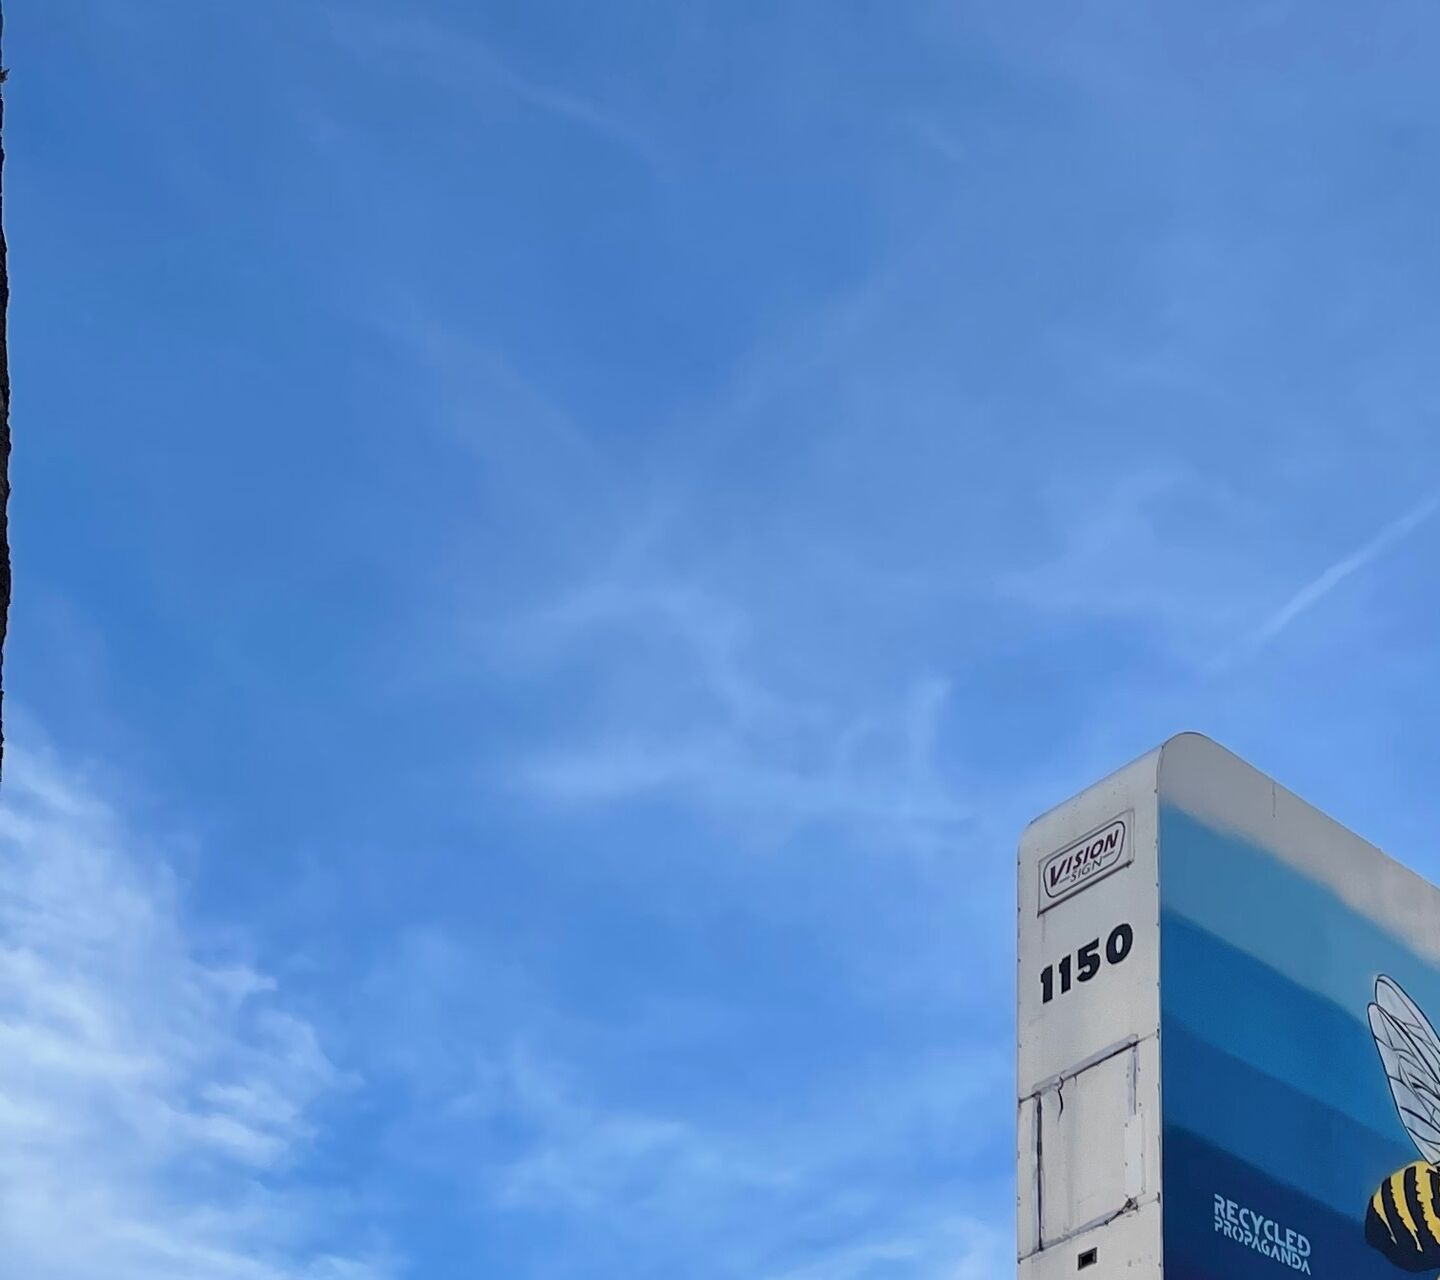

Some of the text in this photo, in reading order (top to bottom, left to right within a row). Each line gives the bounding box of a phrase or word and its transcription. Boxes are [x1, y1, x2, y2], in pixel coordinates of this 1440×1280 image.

[1049, 829, 1120, 888] VISION
[1070, 857, 1104, 883] SIGN
[1040, 923, 1134, 1004] 1150
[1213, 1192, 1312, 1258] RECYCLED
[1213, 1214, 1312, 1276] PROPAGANDA
